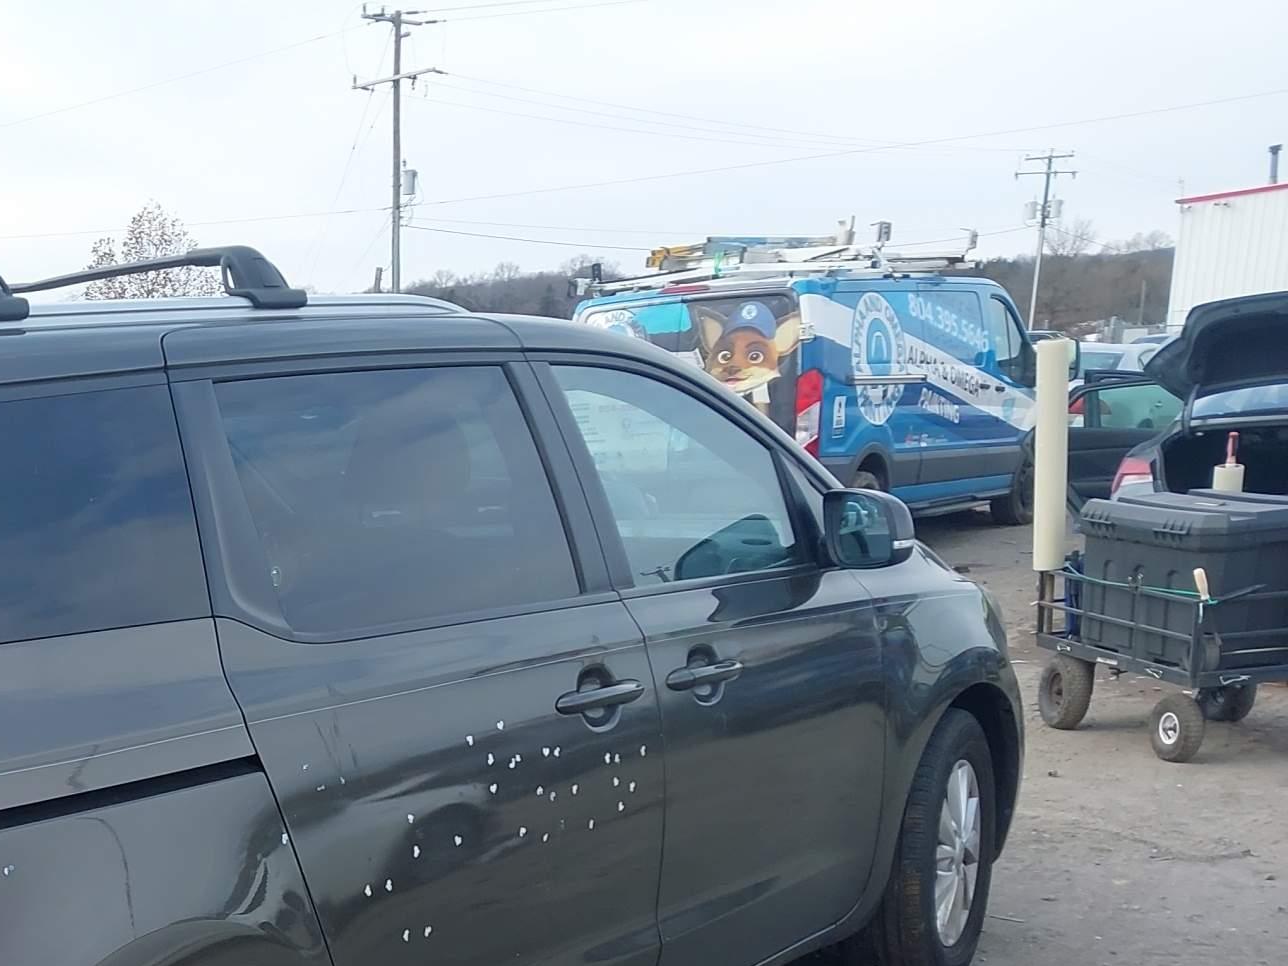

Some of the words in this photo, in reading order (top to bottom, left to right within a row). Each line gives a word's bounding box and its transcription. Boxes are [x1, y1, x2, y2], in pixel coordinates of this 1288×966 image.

[908, 293, 989, 353] 804.395.5646
[907, 346, 941, 379] ALPHA
[950, 365, 981, 398] OMEGA
[919, 387, 961, 424] PAINTING
